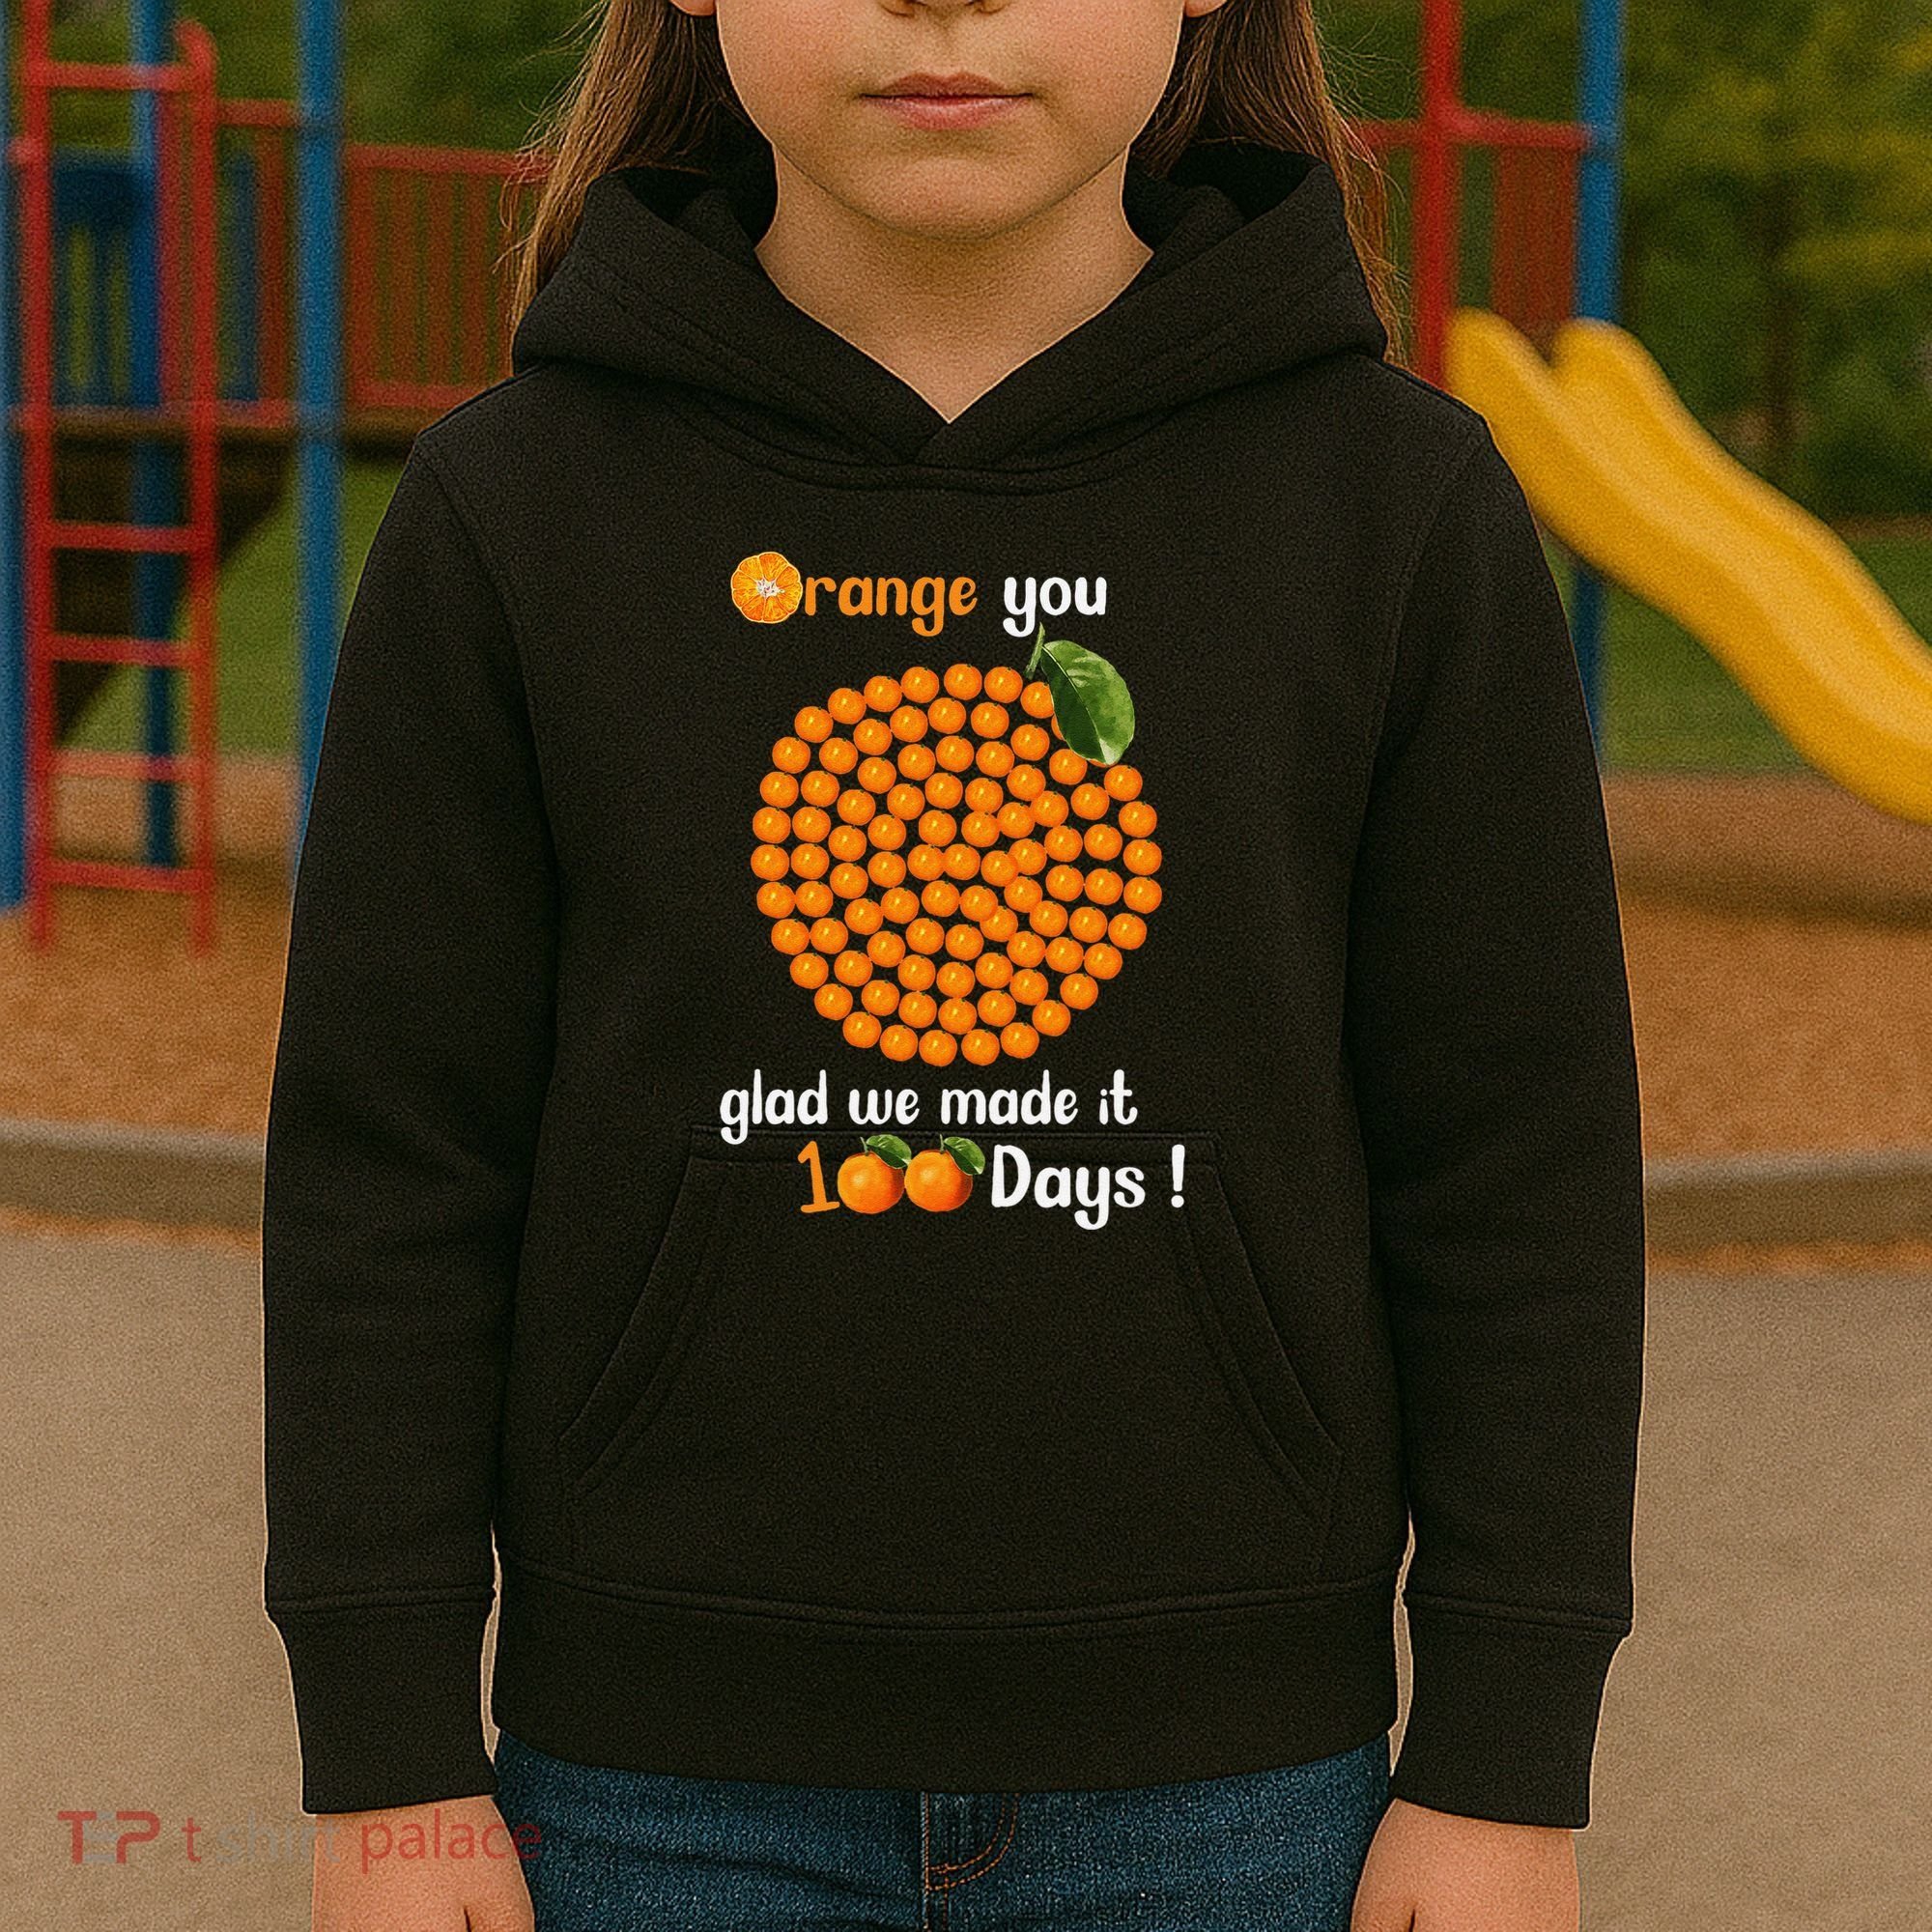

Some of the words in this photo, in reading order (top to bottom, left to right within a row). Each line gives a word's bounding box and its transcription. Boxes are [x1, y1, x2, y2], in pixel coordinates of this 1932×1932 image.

[1003, 577, 1107, 637] you
[720, 1068, 828, 1145] glad
[848, 1088, 920, 1124] we
[940, 1068, 1078, 1125] made
[1099, 1068, 1139, 1124] it
[991, 1144, 1147, 1230] Days
